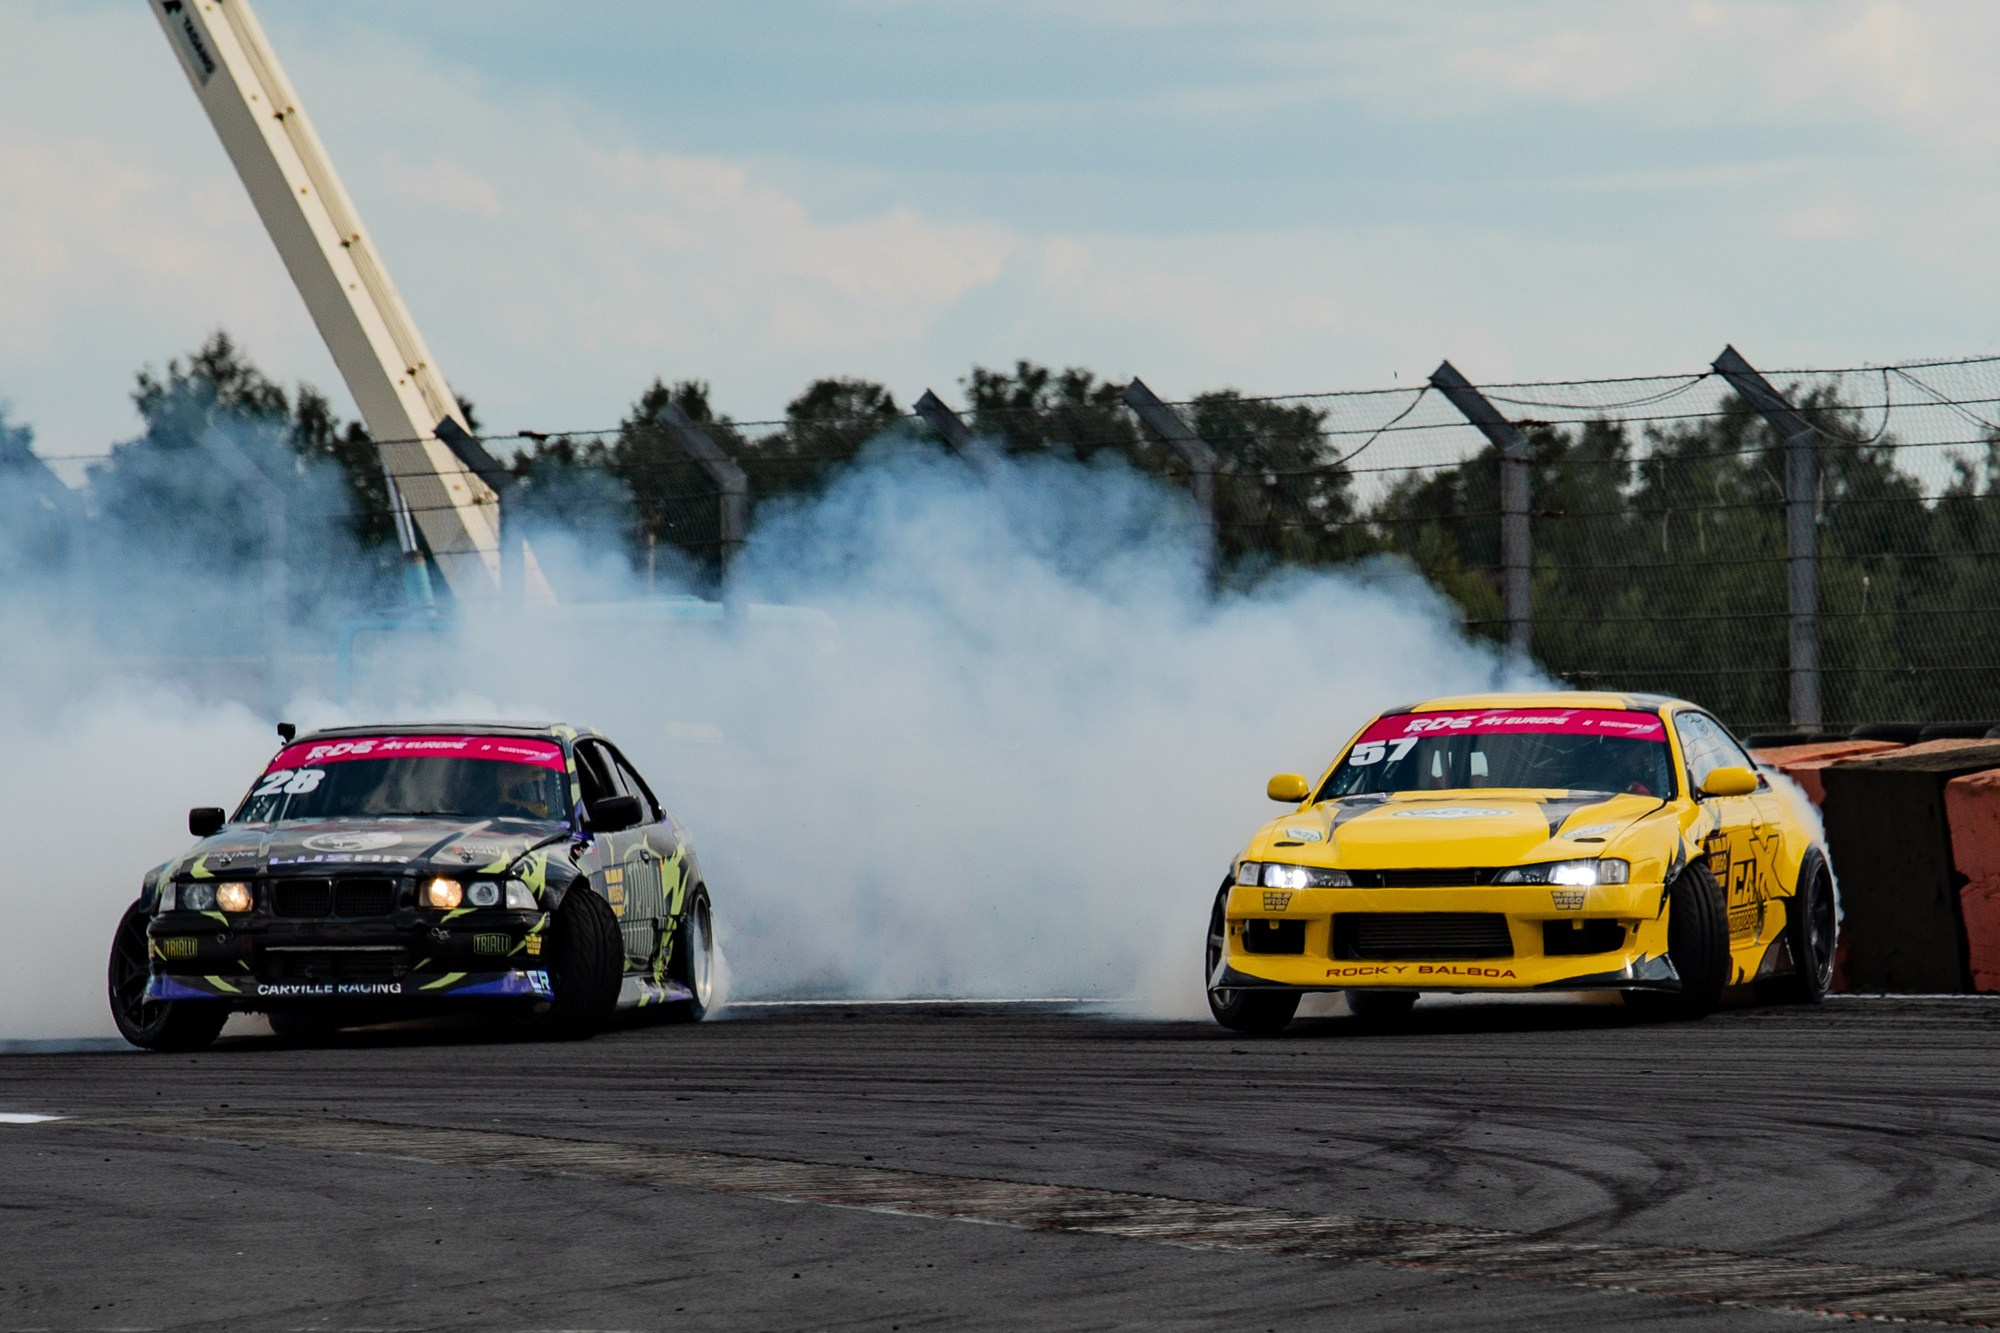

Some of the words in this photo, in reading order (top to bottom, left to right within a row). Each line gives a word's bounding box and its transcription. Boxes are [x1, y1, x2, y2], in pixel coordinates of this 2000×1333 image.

[1403, 715, 1478, 733] RDS
[1504, 717, 1569, 725] EUROPE
[305, 740, 379, 760] RDS
[405, 741, 467, 749] EUROPE
[1348, 736, 1419, 766] 57
[252, 769, 326, 797] 28
[165, 939, 196, 957] TRIALLI
[475, 935, 509, 953] TRIALLI
[526, 970, 551, 990] CR
[1326, 965, 1408, 977] ROCKY
[1418, 965, 1517, 979] BALBOA
[257, 983, 334, 995] CARVILLE
[338, 982, 402, 994] RACING
